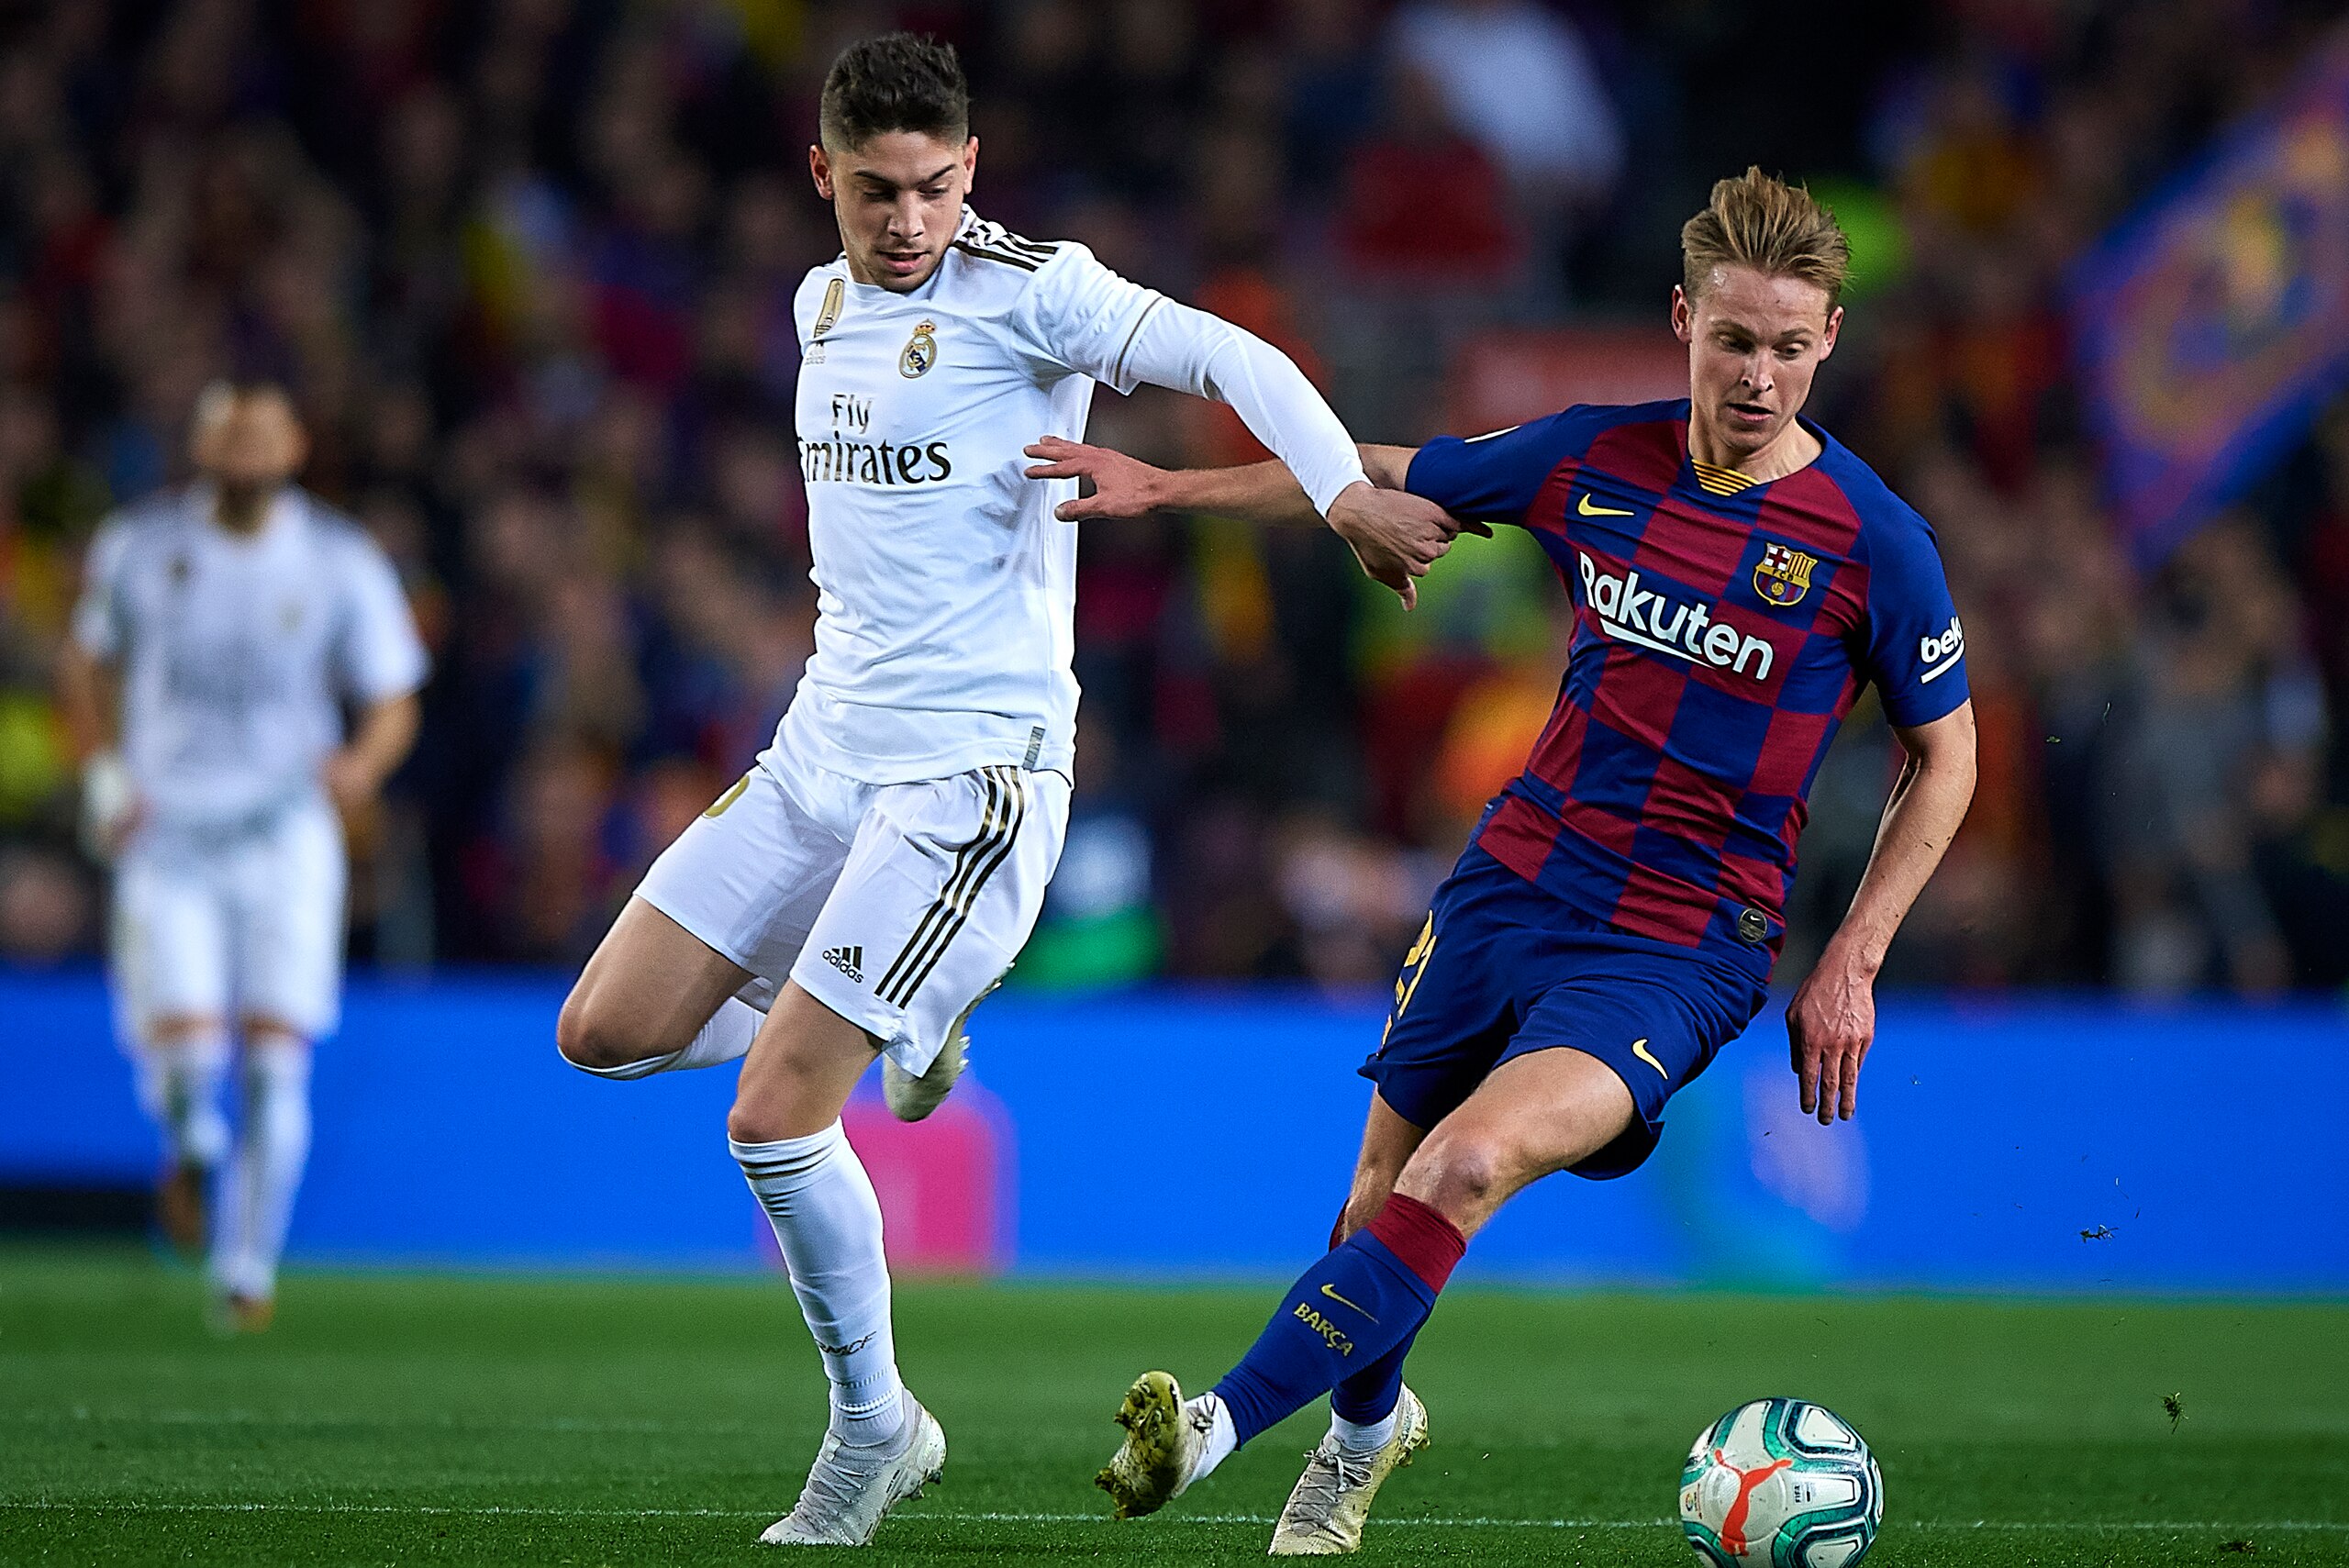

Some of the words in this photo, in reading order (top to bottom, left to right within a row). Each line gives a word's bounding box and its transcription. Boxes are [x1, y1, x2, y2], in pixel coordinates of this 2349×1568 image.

[831, 395, 872, 434] Fly
[798, 430, 952, 484] mirates
[1579, 550, 1774, 681] Rakuten
[1921, 616, 1964, 663] bek
[822, 950, 864, 984] adidas
[1294, 1302, 1353, 1356] BARÇA
